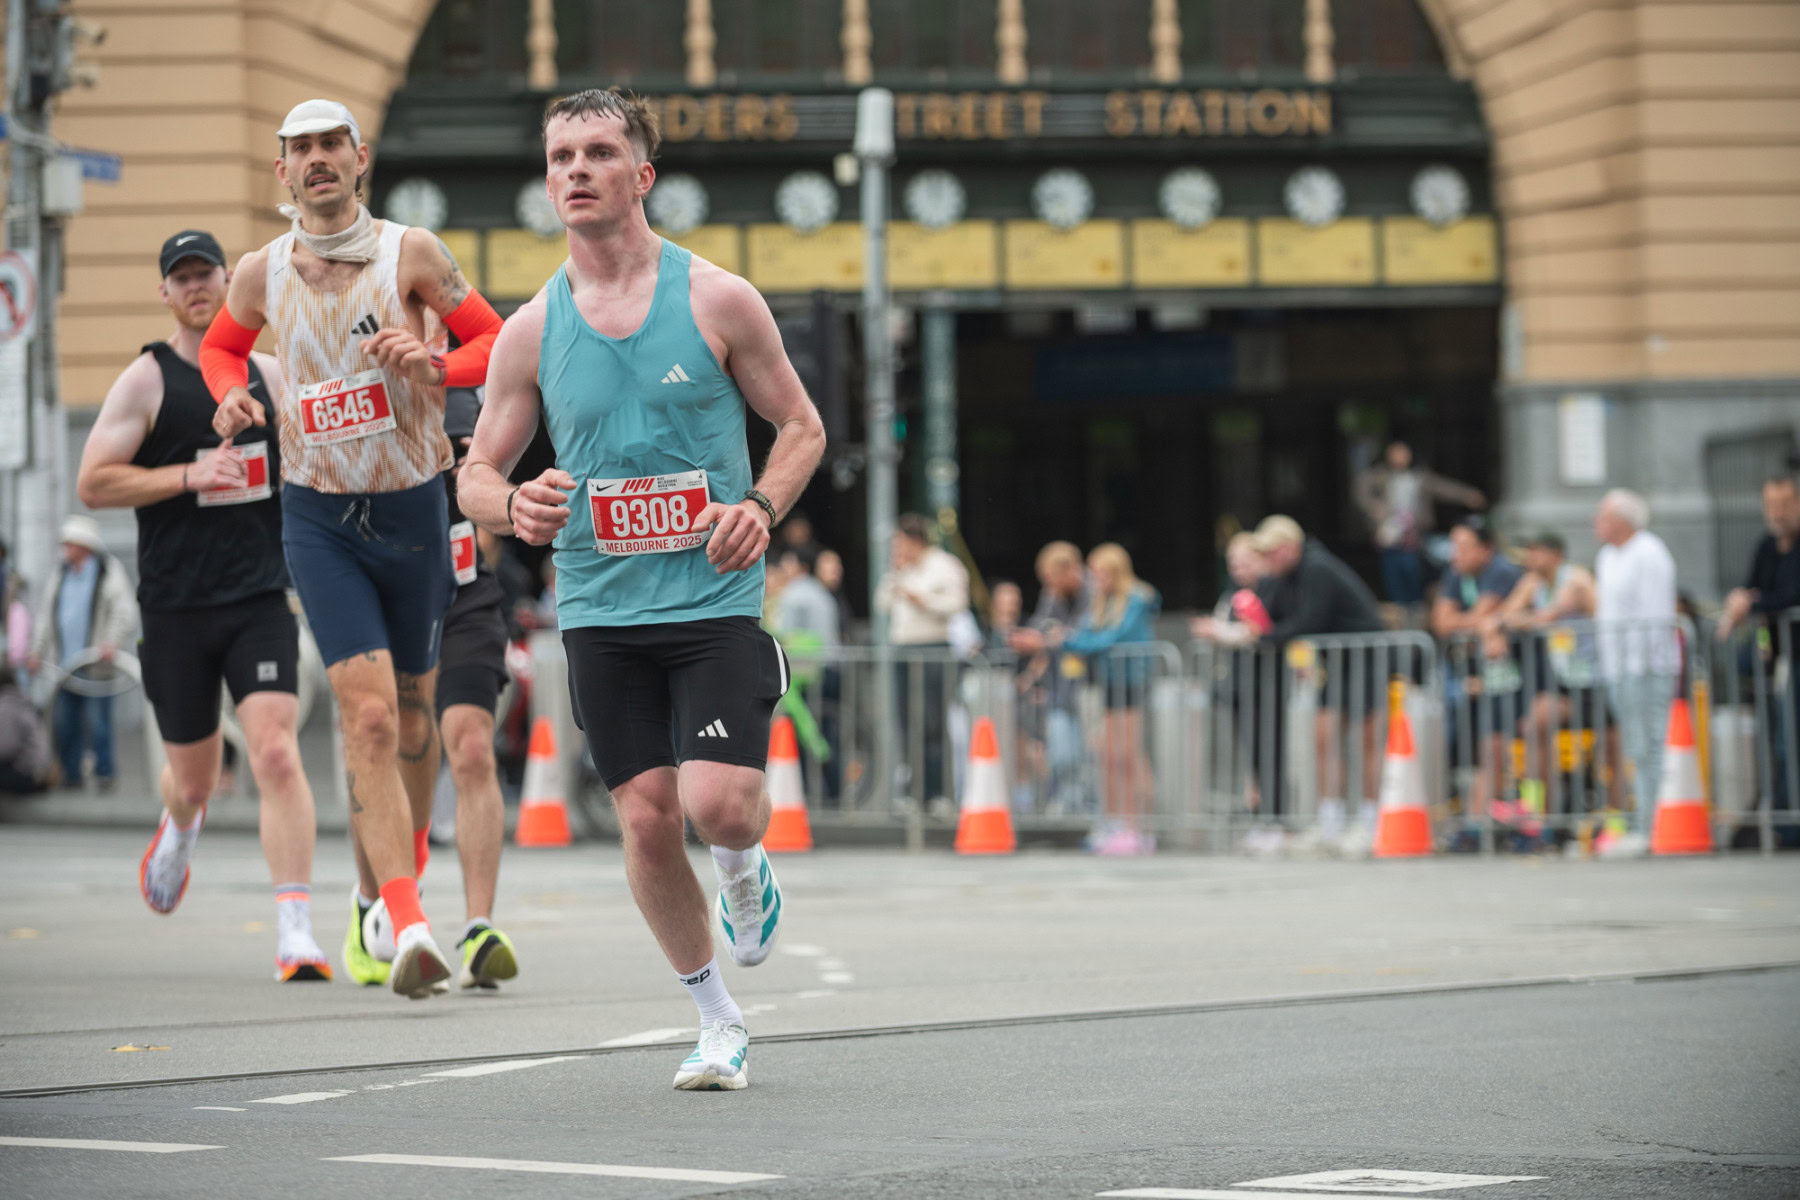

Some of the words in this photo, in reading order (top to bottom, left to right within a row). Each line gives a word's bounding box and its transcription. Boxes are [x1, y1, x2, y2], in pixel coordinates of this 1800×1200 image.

[895, 92, 1048, 139] TREET
[1105, 89, 1332, 137] STATION
[312, 389, 375, 431] 6545
[312, 427, 360, 442] MELBOURNE
[364, 420, 387, 433] 2025
[610, 495, 690, 538] 9308
[606, 539, 670, 553] MELBOURNE
[673, 535, 702, 548] 2025
